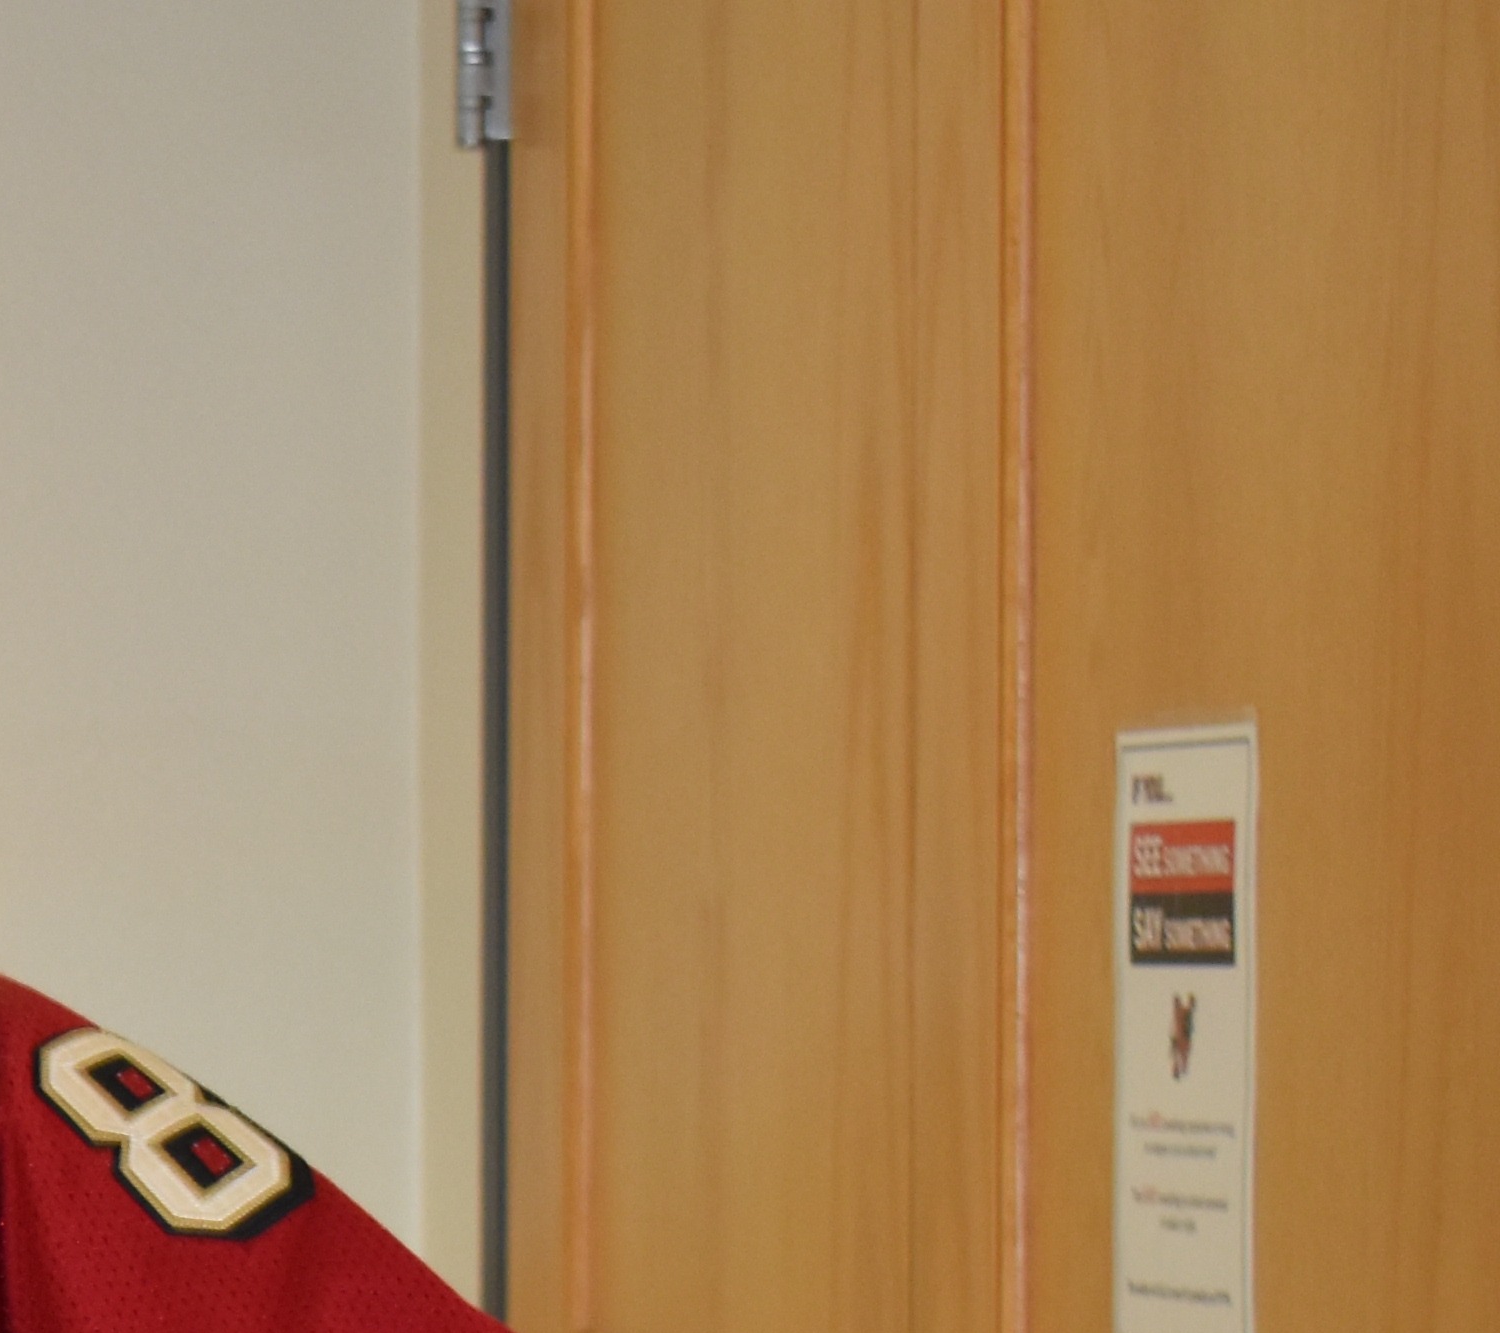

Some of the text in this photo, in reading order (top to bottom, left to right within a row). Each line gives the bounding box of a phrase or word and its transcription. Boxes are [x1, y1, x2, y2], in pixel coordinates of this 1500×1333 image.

[1134, 833, 1163, 878] SEE
[1134, 907, 1163, 951] SAY
[34, 1027, 315, 1241] 8
